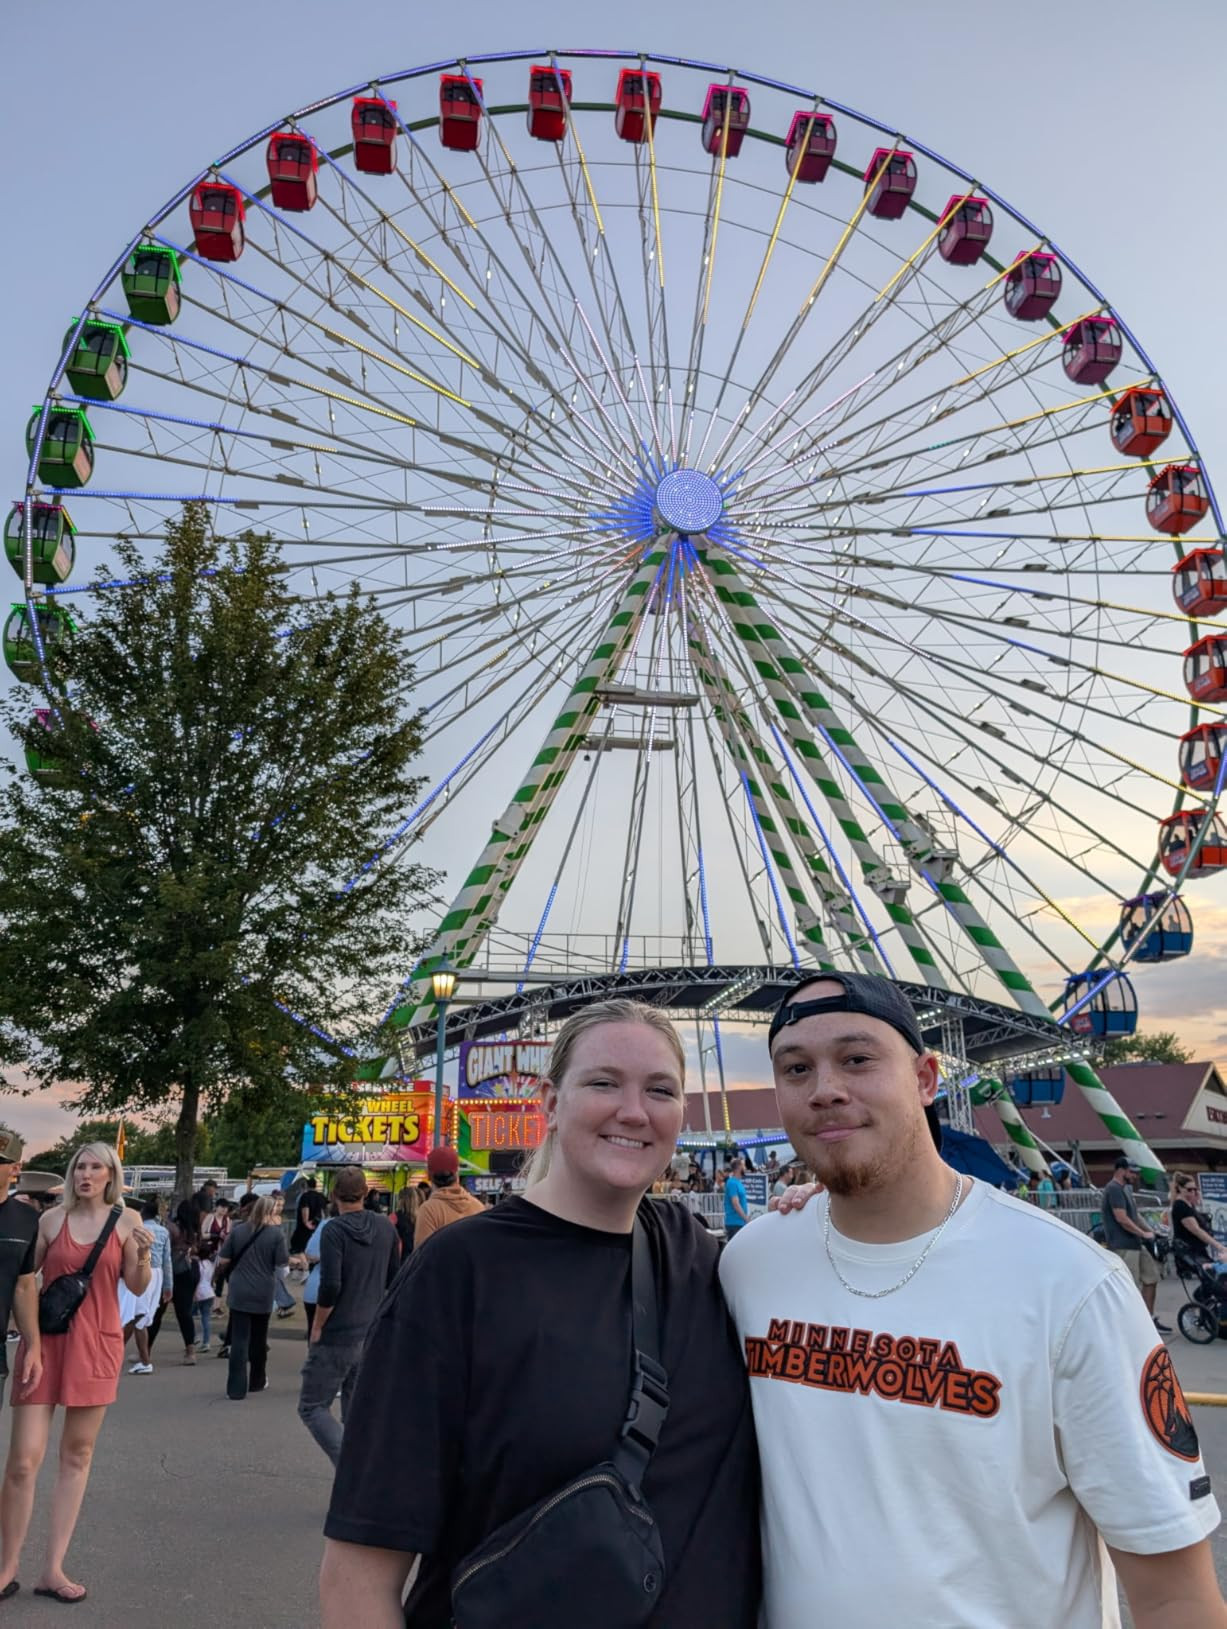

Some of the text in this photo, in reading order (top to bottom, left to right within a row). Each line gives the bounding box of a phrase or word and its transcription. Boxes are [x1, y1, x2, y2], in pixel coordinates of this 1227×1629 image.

[467, 1045, 514, 1088] GIANT
[367, 1100, 414, 1113] WHEEL
[311, 1115, 420, 1145] TICKETS
[768, 1318, 963, 1370] MINNESOTA
